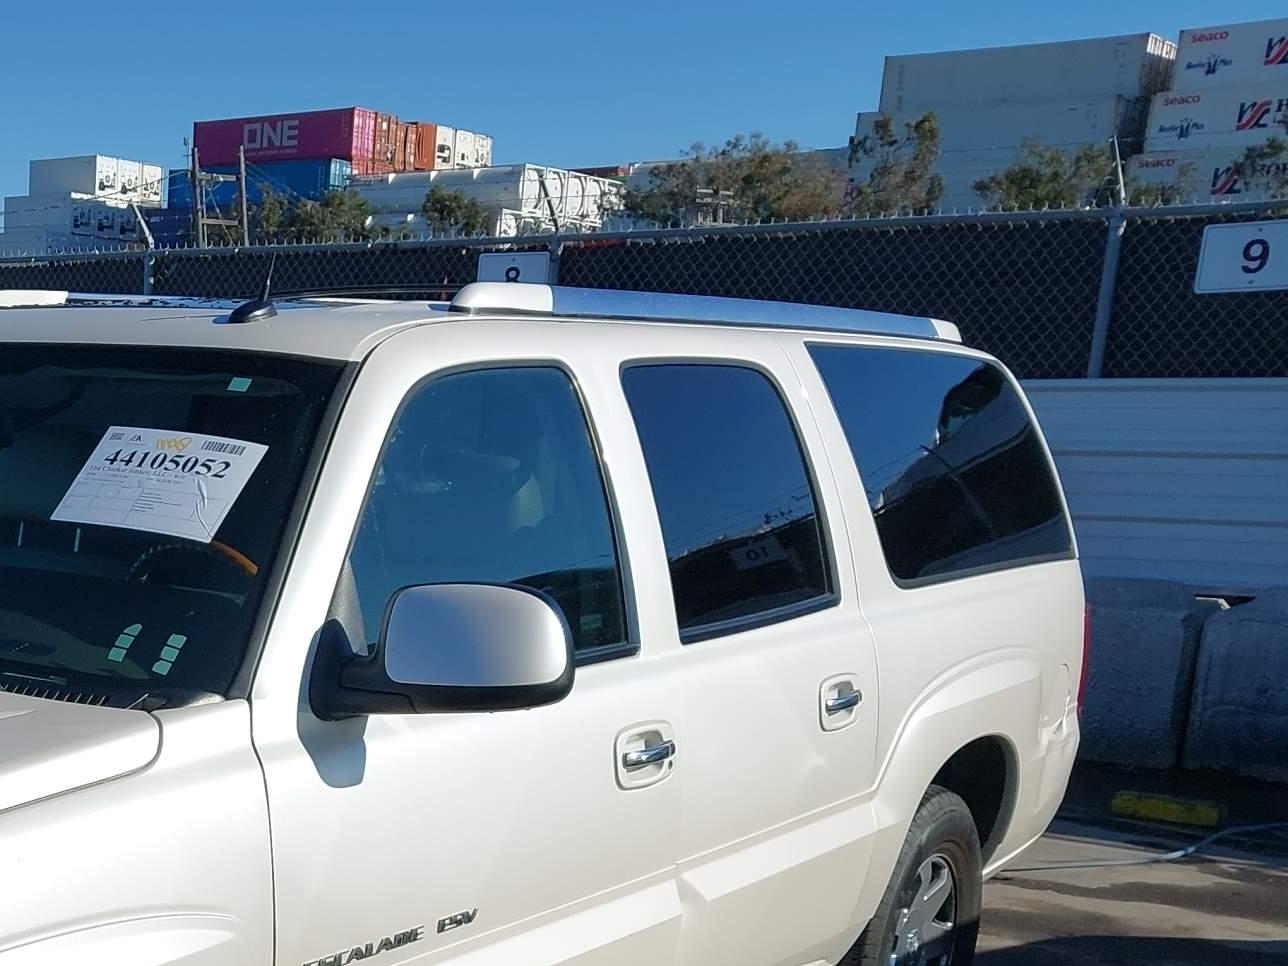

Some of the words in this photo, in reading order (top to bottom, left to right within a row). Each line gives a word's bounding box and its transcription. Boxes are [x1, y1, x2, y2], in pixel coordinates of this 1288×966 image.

[1192, 31, 1229, 43] seaco
[1163, 95, 1201, 106] seaco
[243, 119, 300, 149] ONE
[1137, 158, 1176, 169] seaco
[1240, 238, 1270, 274] 9
[103, 448, 232, 479] 44105052
[437, 907, 479, 934] ESV
